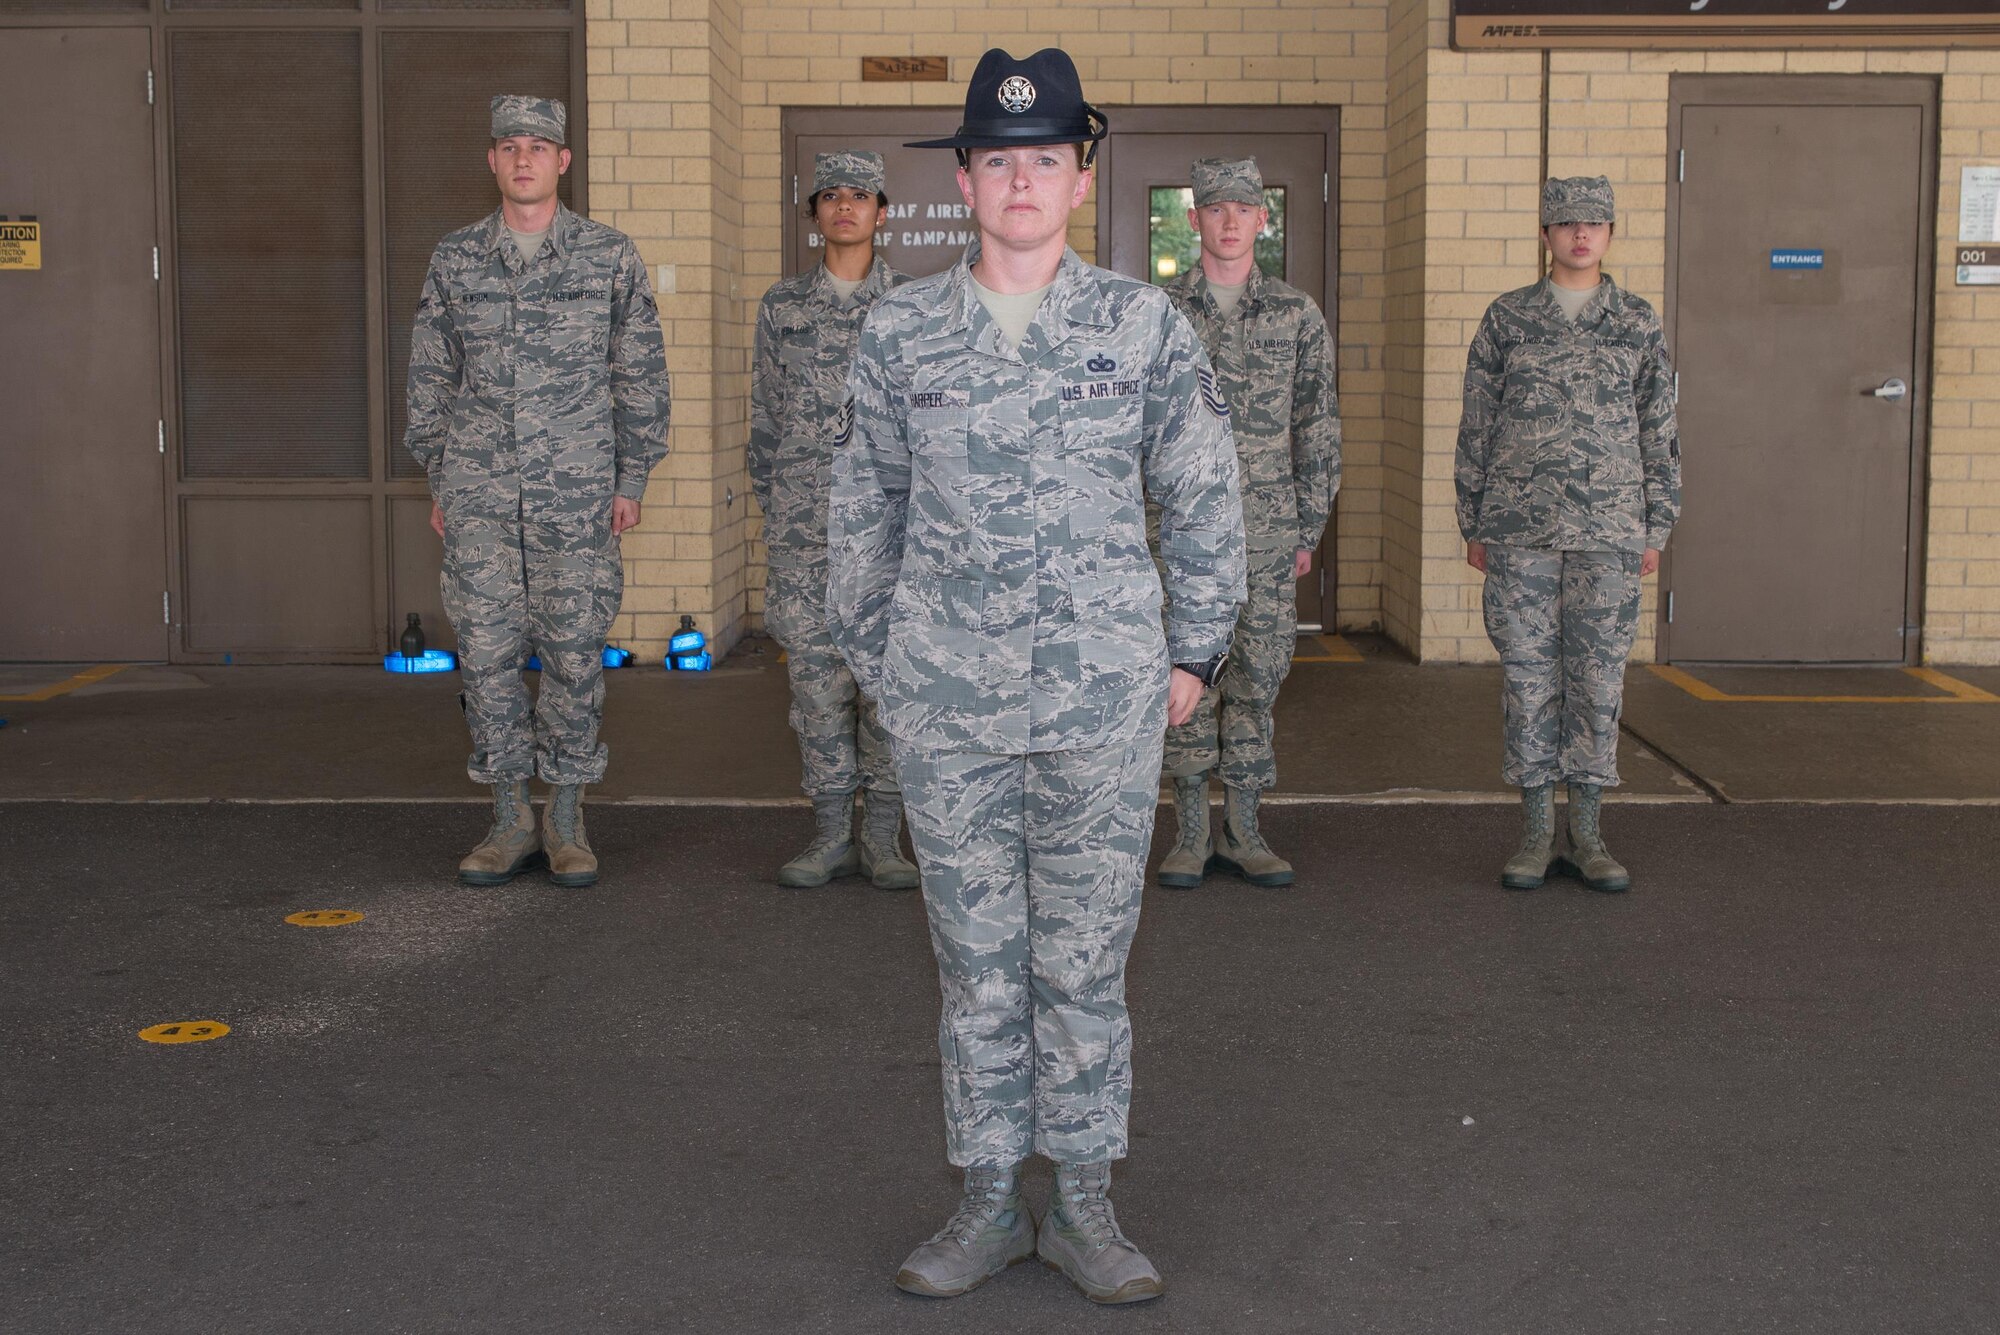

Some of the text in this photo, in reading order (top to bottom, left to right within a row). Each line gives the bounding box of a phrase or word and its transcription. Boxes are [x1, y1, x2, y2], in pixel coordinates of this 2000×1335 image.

[926, 203, 973, 218] AIREY
[1772, 254, 1823, 264] ENTRANCE
[1960, 250, 1986, 263] 001
[580, 290, 606, 301] FORCE
[1062, 380, 1140, 401] U.S. AIR FORCE
